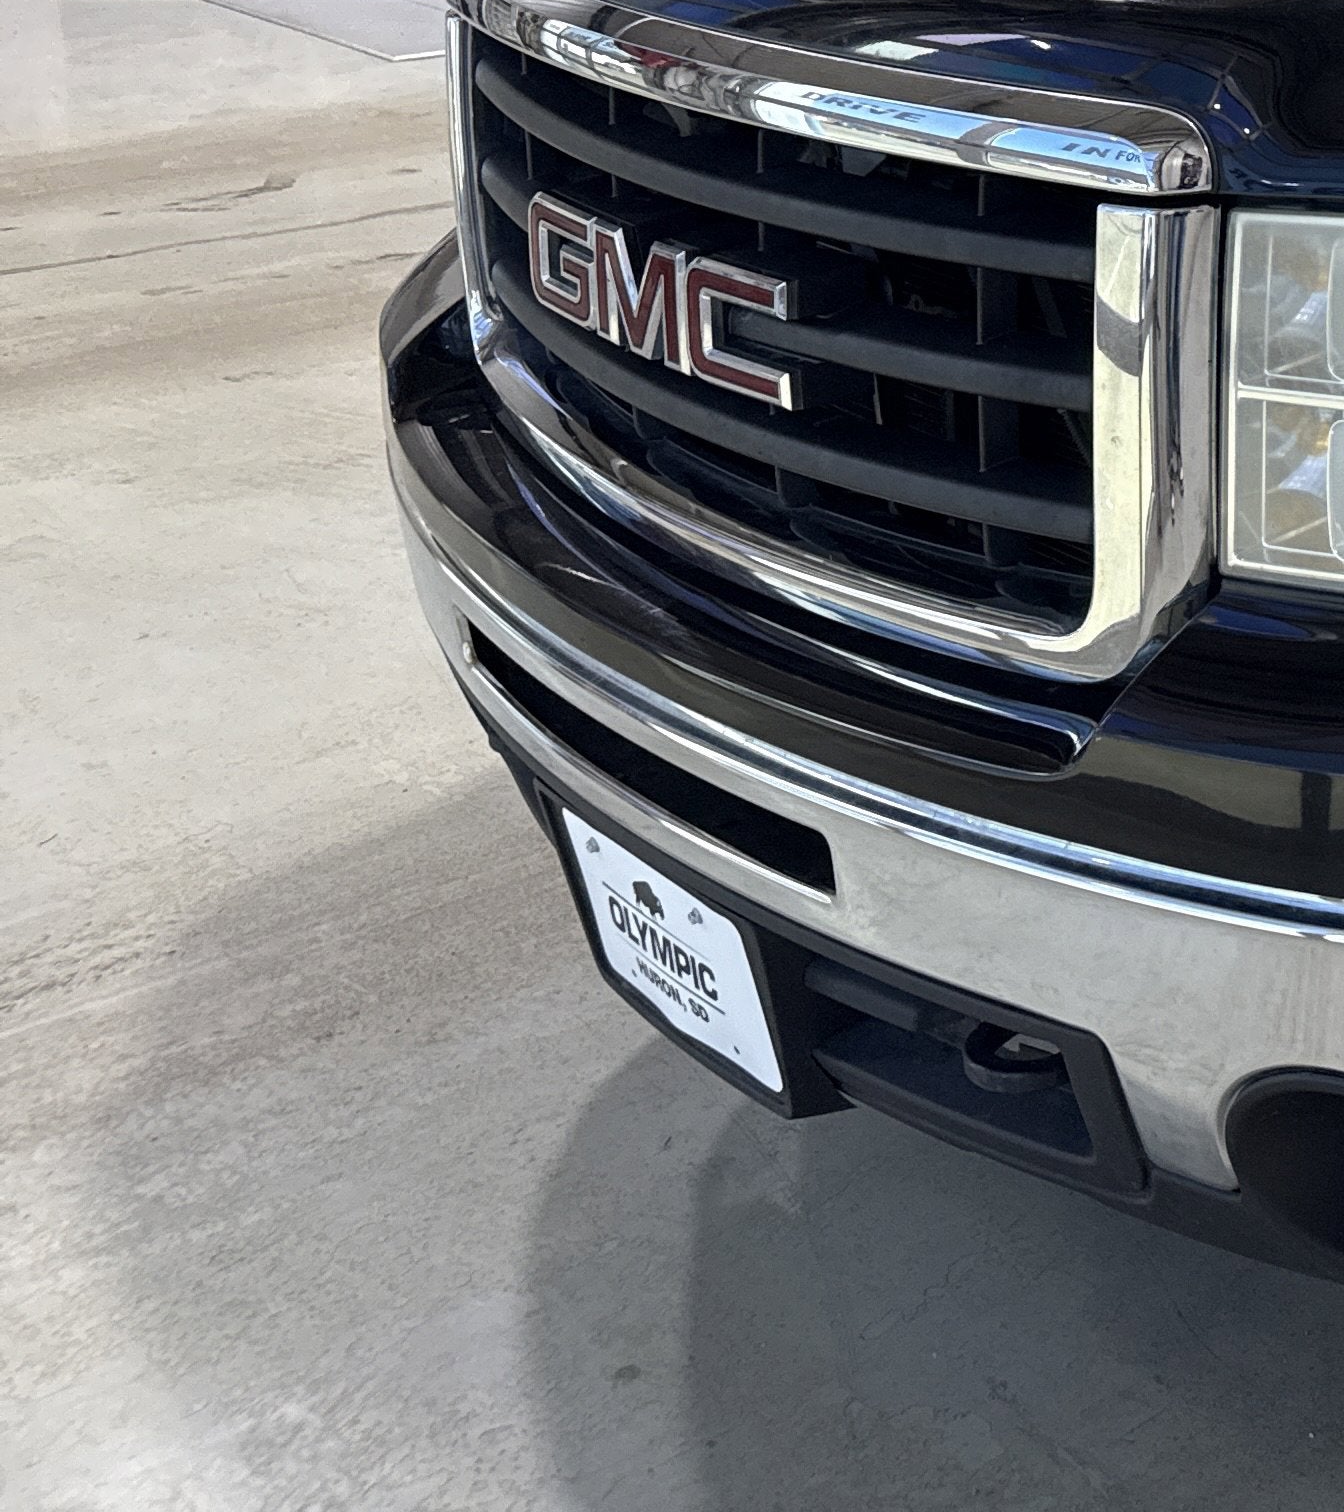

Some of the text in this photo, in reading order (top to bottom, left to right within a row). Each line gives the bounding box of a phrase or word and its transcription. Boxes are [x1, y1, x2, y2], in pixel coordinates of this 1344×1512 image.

[801, 90, 1111, 159] DRIVE IN
[527, 190, 797, 411] GMC
[608, 894, 719, 1002] OLYMPIC
[635, 955, 711, 1024] HURON, SD
